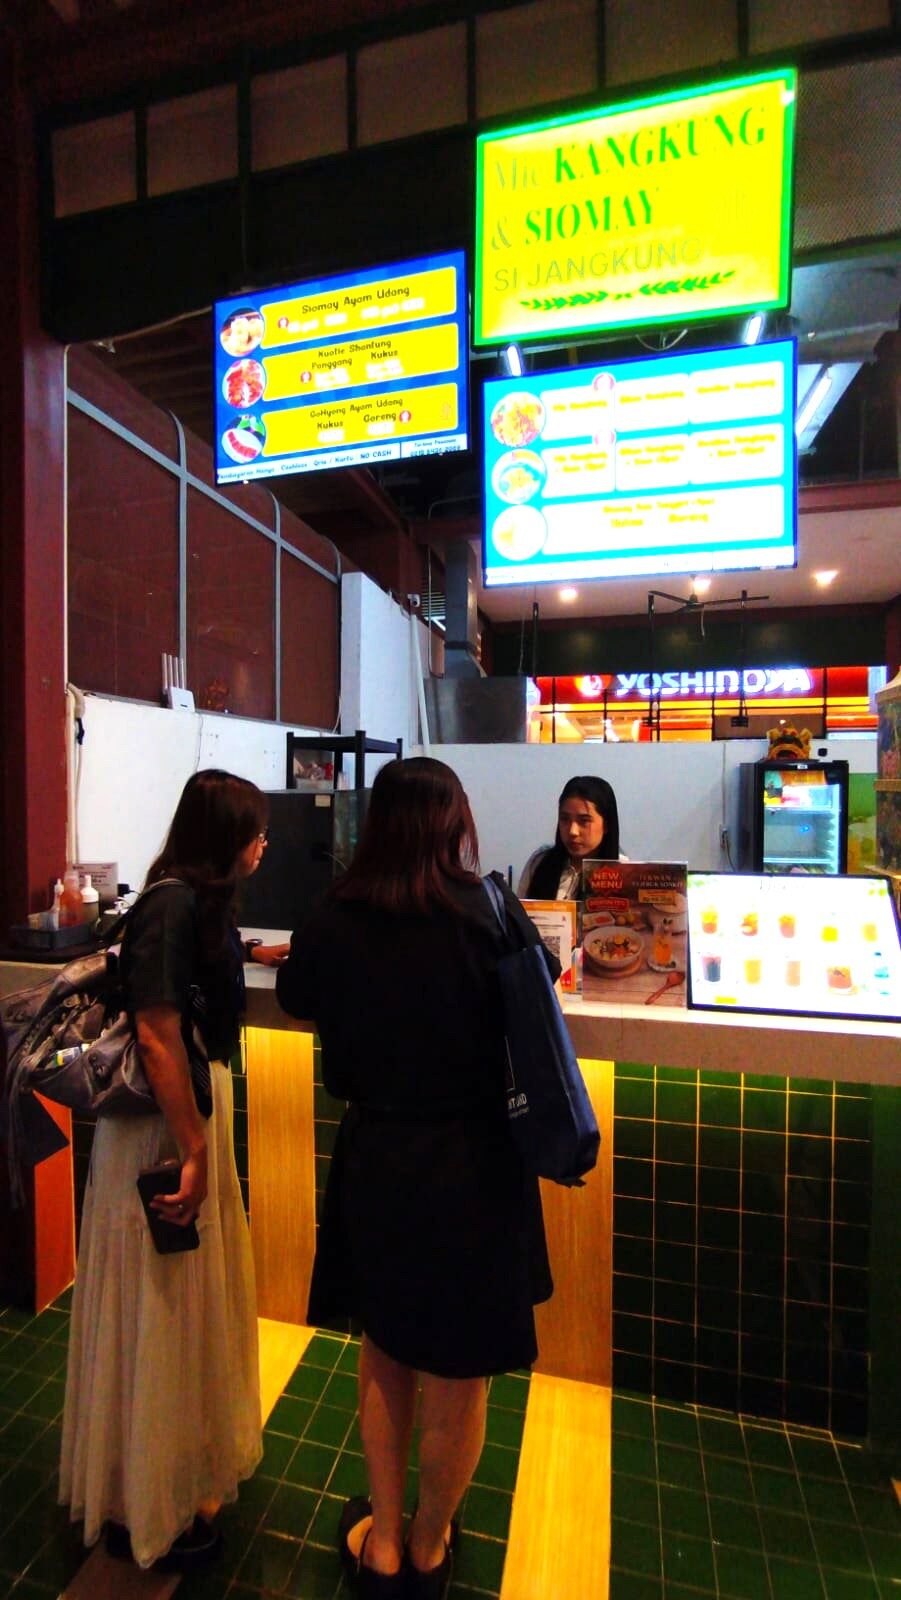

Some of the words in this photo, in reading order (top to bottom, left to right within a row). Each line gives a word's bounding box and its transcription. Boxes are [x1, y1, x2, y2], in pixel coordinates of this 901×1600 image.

[555, 106, 766, 183] KANGKUNG
[525, 186, 661, 246] SIOMAY
[494, 267, 518, 292] SI
[527, 237, 702, 288] JANGKUNG
[302, 301, 339, 315] Siomay
[343, 294, 373, 307] Ayam
[376, 287, 410, 300] Udang
[370, 349, 398, 360] Kukus
[349, 403, 373, 413] Ayam
[376, 399, 403, 408] Udang
[316, 421, 344, 430] Kukus
[363, 412, 397, 423] Goreng
[372, 449, 392, 458] CASH
[591, 880, 623, 888] MENU
[593, 872, 620, 880] NEW
